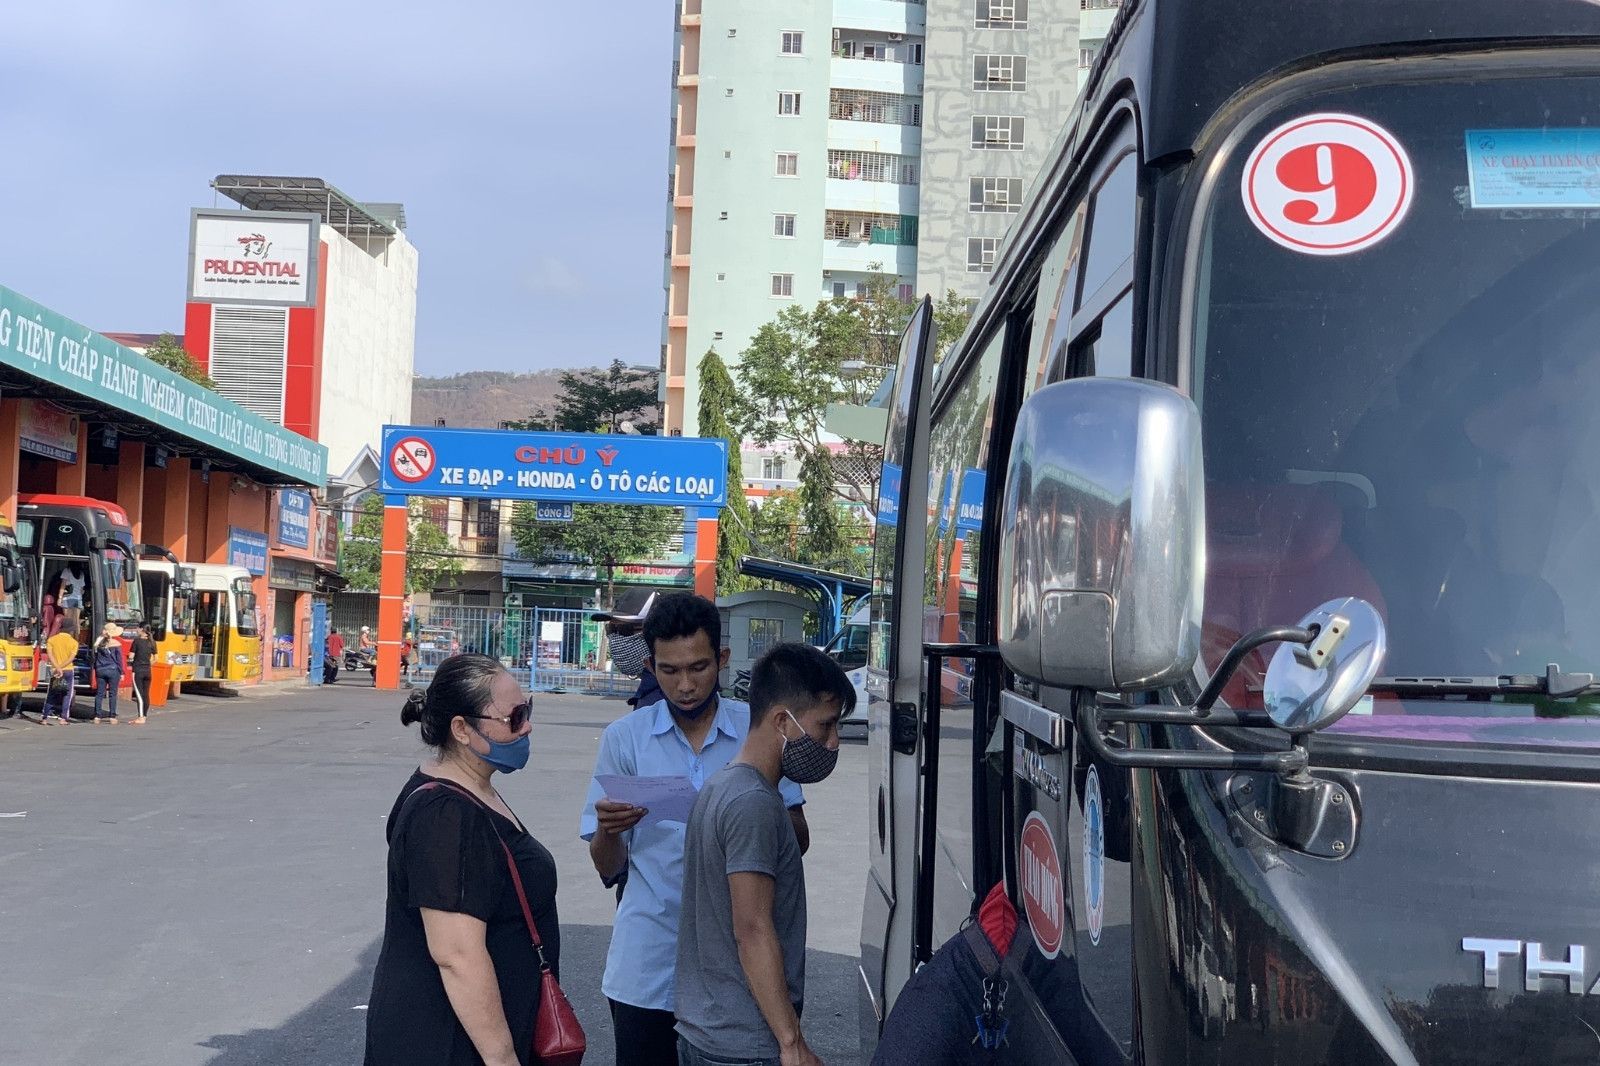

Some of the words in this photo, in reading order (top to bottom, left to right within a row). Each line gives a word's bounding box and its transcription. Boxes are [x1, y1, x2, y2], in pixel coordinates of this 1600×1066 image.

[1276, 142, 1377, 226] 9
[204, 259, 300, 277] PRUDENTIAL
[16, 313, 55, 369] TIỆN
[58, 330, 99, 382] CHẤP
[101, 347, 139, 400] HÀNH
[141, 373, 185, 421] NGHIÊM
[187, 391, 218, 434] CHỈNH
[219, 410, 243, 449] LUẬT
[244, 424, 263, 455] GIAO
[265, 430, 289, 462] THÔNG
[290, 437, 312, 470] ĐƯỜNG
[312, 450, 321, 481] BỘ
[515, 443, 586, 465] CHÚ
[597, 445, 620, 466] Ý
[440, 467, 463, 485] XE
[468, 468, 503, 490] ĐẠP
[517, 471, 576, 490] HONDA
[590, 469, 602, 491] Ô
[608, 469, 632, 492] TÔ
[635, 471, 671, 493] CÁC
[675, 478, 714, 499] LOẠI
[563, 505, 572, 518] B
[1461, 937, 1600, 997] TH
